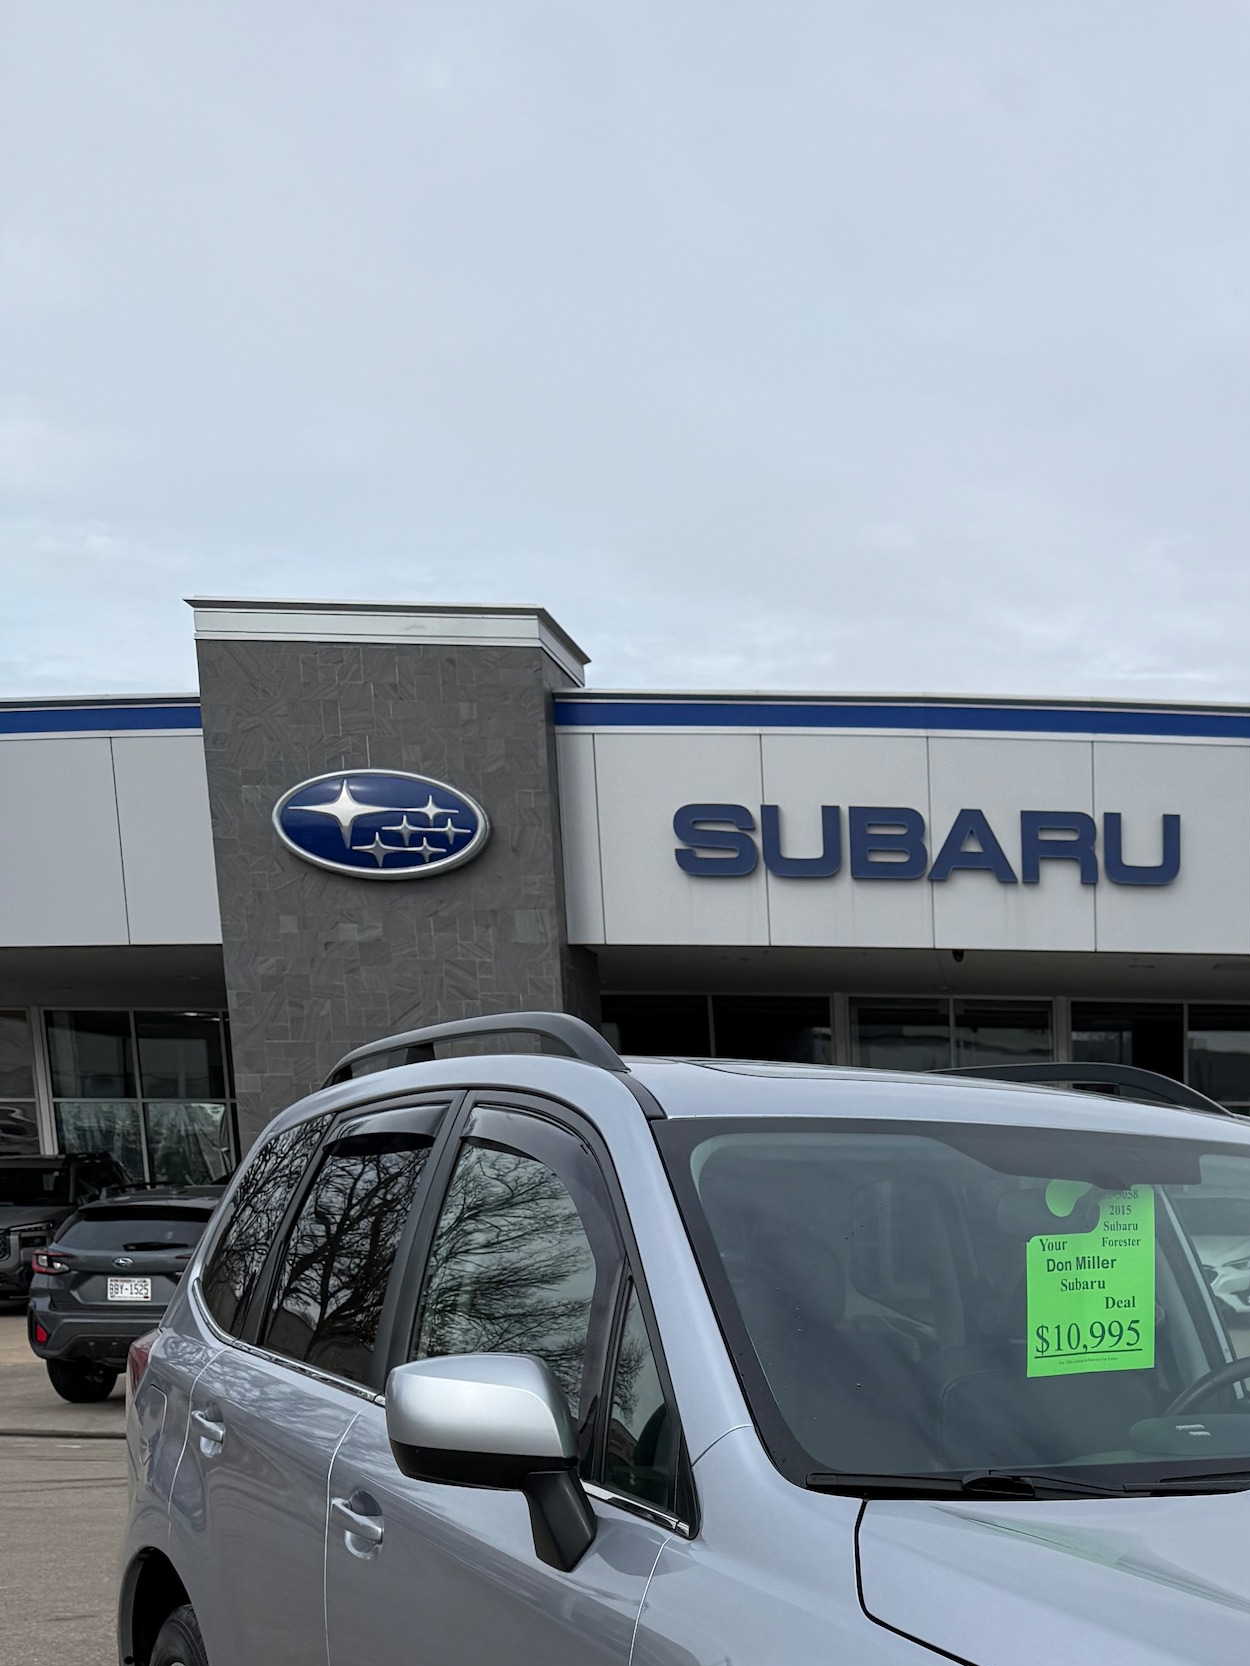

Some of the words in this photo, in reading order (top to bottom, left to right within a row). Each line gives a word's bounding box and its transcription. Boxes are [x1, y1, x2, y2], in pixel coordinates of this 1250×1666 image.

[672, 803, 1181, 886] SUBARU
[1109, 1204, 1132, 1216] 2015
[1103, 1220, 1138, 1231] Subaru
[1039, 1238, 1067, 1252] Your
[1102, 1236, 1141, 1247] Forester
[1046, 1258, 1072, 1272] Don
[1076, 1255, 1117, 1270] Miller
[1060, 1277, 1106, 1292] Subaru
[1105, 1295, 1136, 1309] Deal
[1035, 1319, 1141, 1356] $10,995
